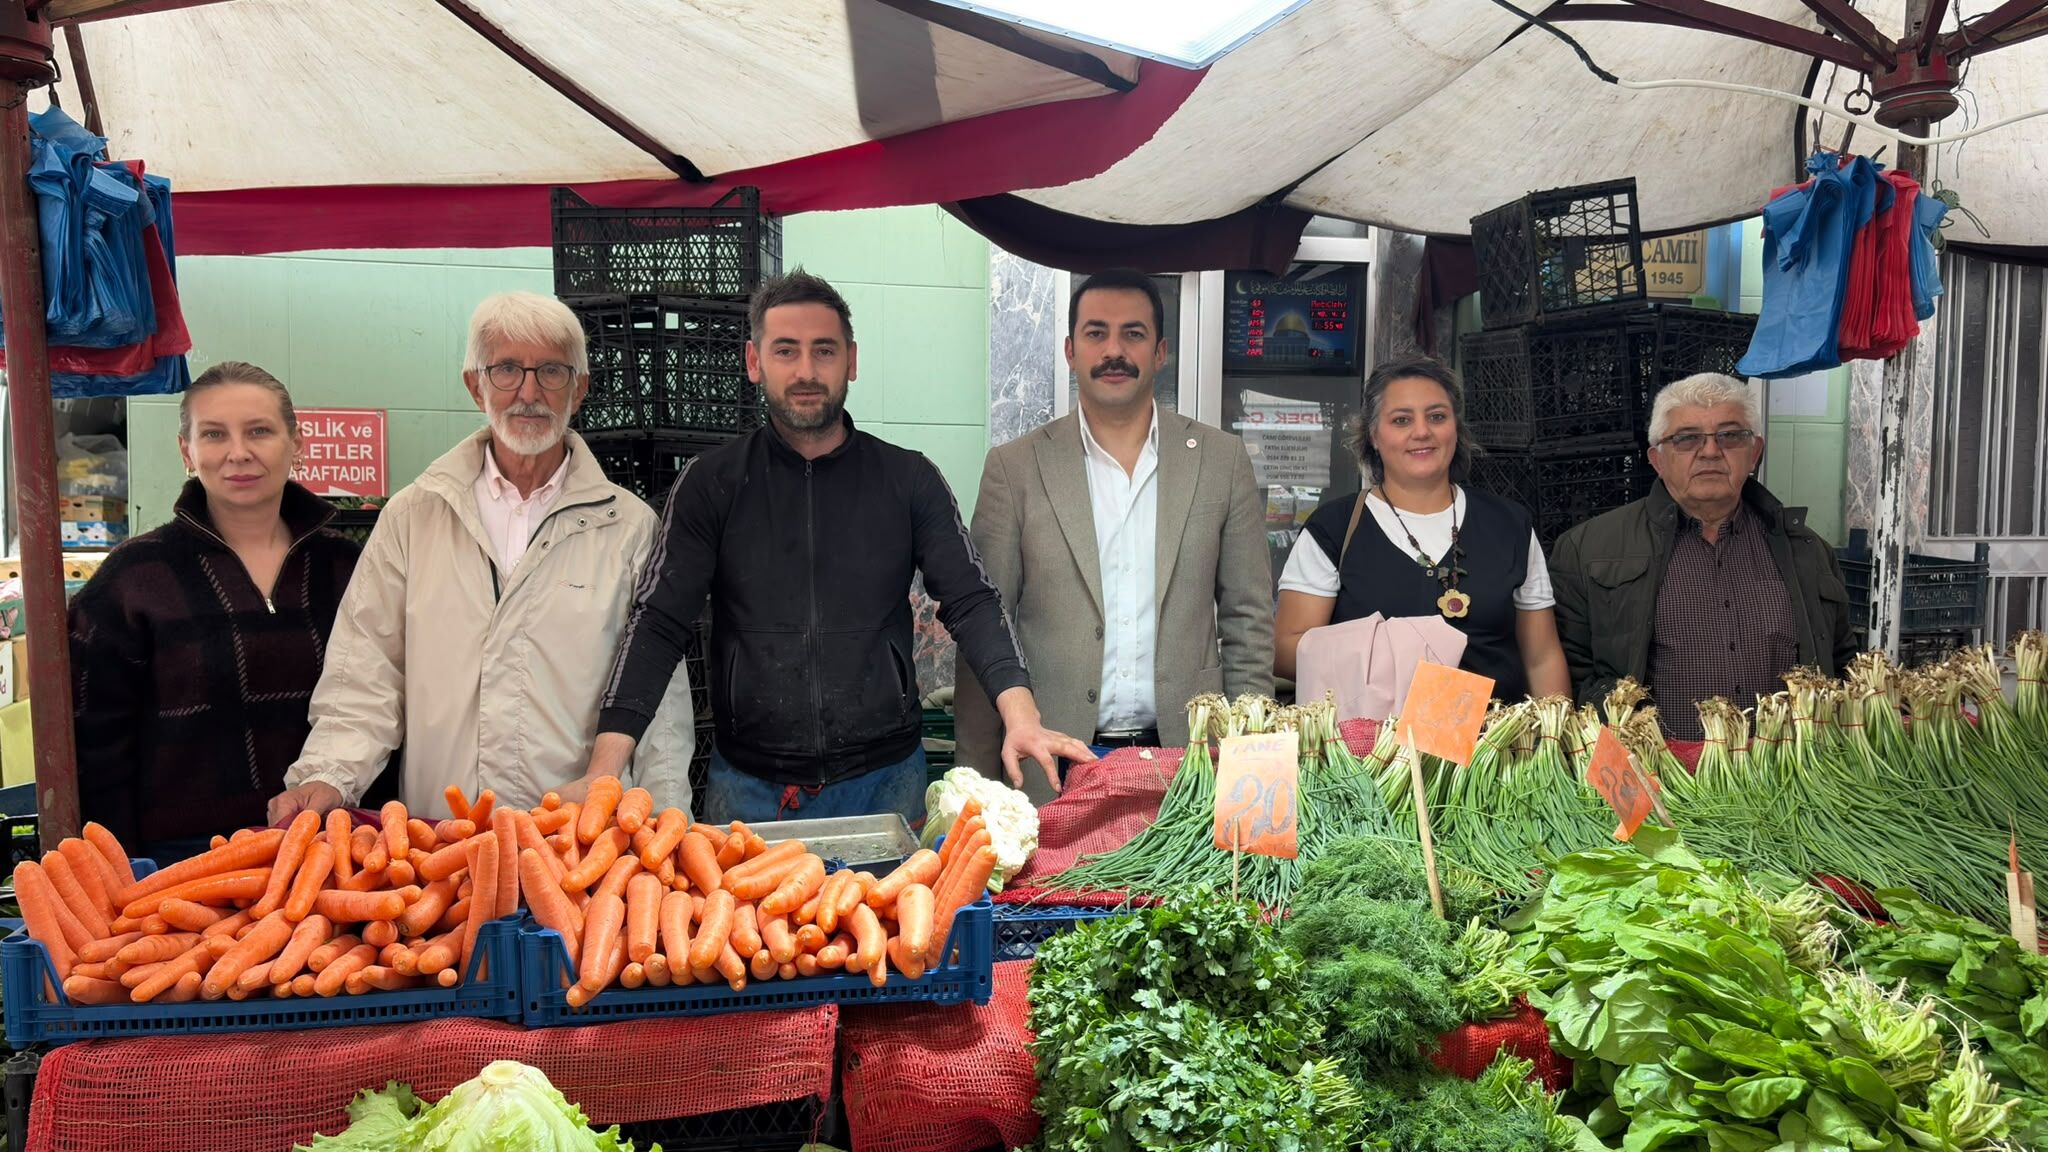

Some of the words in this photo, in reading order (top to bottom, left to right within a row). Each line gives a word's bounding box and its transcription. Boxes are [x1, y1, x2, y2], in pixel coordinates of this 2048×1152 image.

[1650, 271, 1684, 285] 1945
[296, 417, 346, 438] SLİK
[350, 424, 373, 438] ve
[304, 443, 374, 460] ETLER
[288, 464, 377, 482] ARAFTADIR
[1222, 774, 1295, 848] 20
